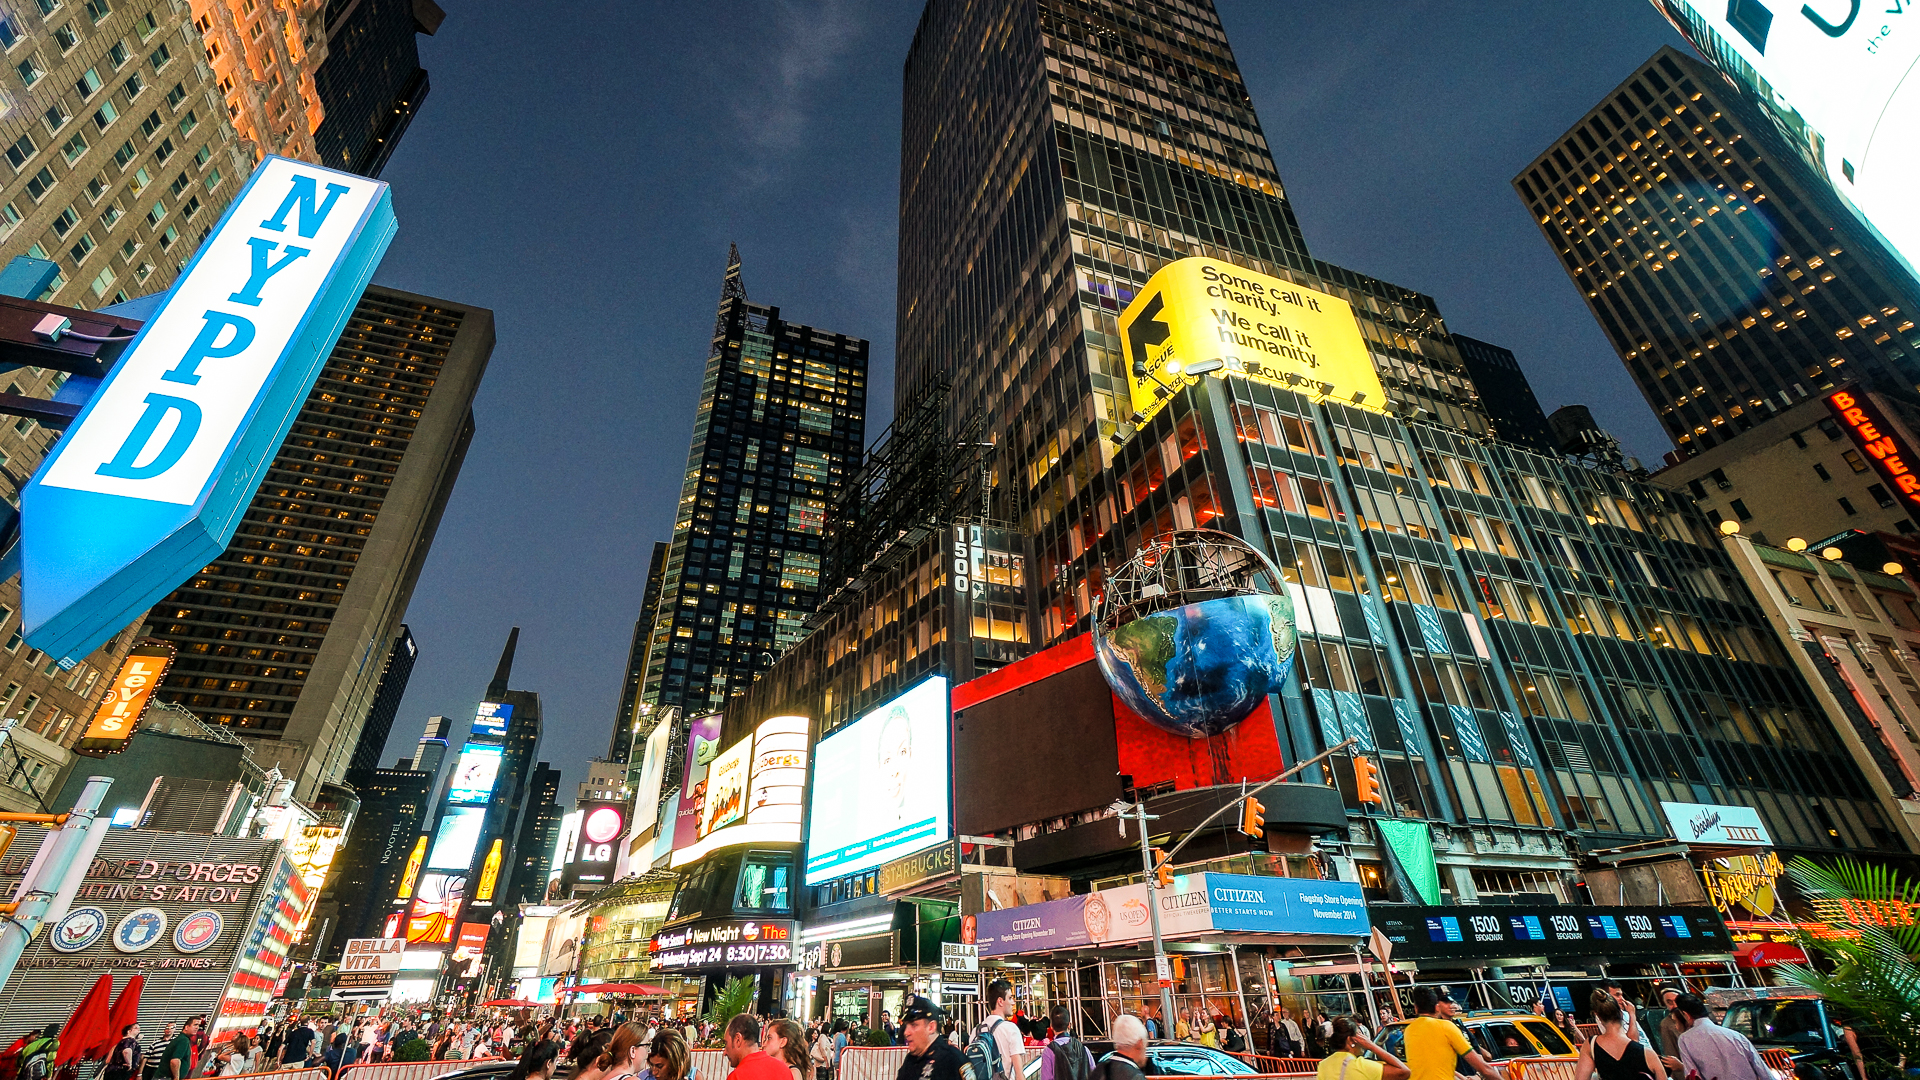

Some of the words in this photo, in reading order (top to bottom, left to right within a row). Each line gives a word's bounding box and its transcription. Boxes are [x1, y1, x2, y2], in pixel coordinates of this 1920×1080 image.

[1201, 265, 1264, 295] Some
[1270, 287, 1301, 307] call
[1306, 296, 1322, 313] it
[1206, 283, 1281, 316] charity.
[95, 174, 350, 480] NYPD
[1211, 308, 1251, 331] We
[1257, 321, 1292, 343] call
[1296, 329, 1313, 348] it
[1217, 326, 1320, 368] humanity.
[1137, 345, 1175, 389] RESCUE
[1807, 531, 1848, 552] ANDMARK
[954, 527, 969, 592] 1500
[101, 662, 152, 731] Levi's
[380, 820, 402, 864] NOVOTEL
[582, 843, 611, 862] LG
[158, 861, 262, 884] FORCES
[884, 847, 951, 886] STARBUCKS
[150, 884, 241, 903] STATION
[1214, 887, 1266, 904] CITIZEN.
[1299, 893, 1324, 905] Flagship
[1324, 894, 1340, 905] Store
[1340, 896, 1364, 907] Opening
[1119, 912, 1127, 921] US
[1128, 909, 1146, 920] OPEN
[1211, 906, 1233, 915] BETTER
[1234, 908, 1257, 916] STARTS
[1313, 909, 1342, 920] November
[1342, 910, 1357, 920] 2014
[1012, 917, 1041, 932] CITIZEN
[1470, 916, 1500, 933] 1500
[1550, 915, 1579, 931] 1500
[1624, 915, 1652, 931] 1500
[693, 929, 710, 943] New
[710, 926, 740, 943] Night
[762, 925, 788, 940] The
[1001, 934, 1013, 943] Flagship
[347, 940, 401, 954] BELLA
[944, 945, 976, 957] BELLA
[18, 957, 60, 968] NAVY
[75, 957, 97, 968] AIR
[102, 958, 147, 969] FORCE
[158, 958, 211, 969] MARINES
[346, 955, 381, 969] VITA
[689, 949, 707, 966] Sept
[708, 947, 722, 963] 24
[944, 957, 967, 969] VITA
